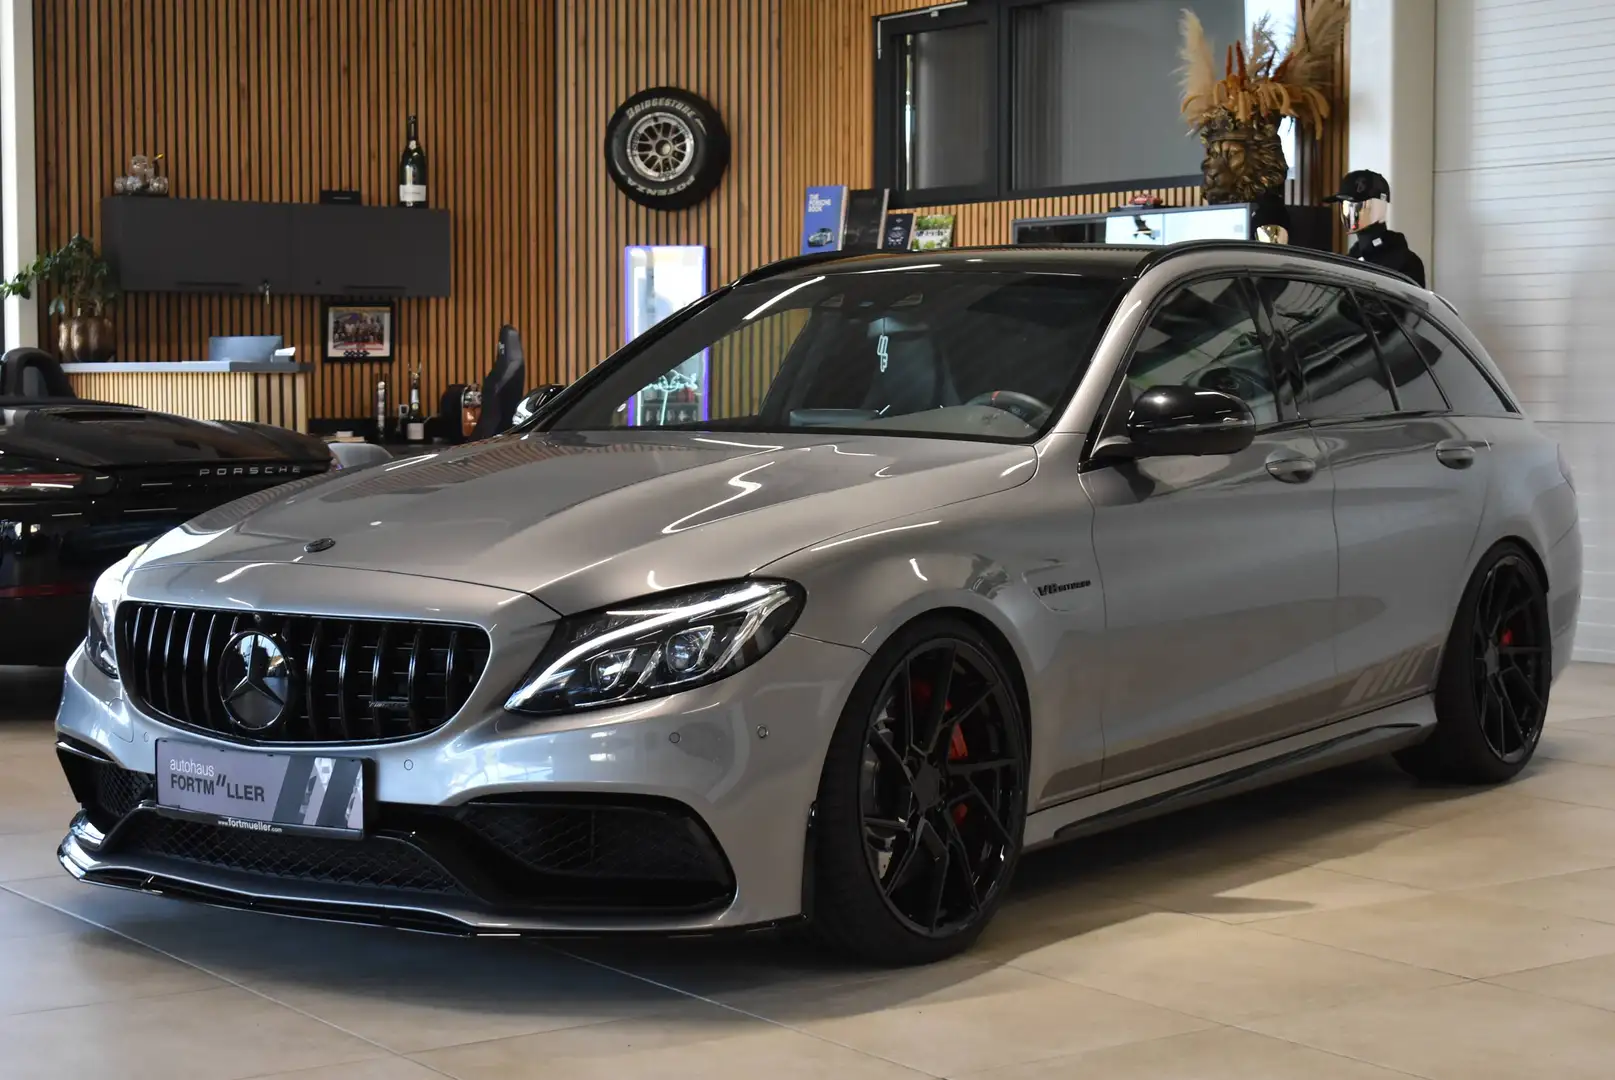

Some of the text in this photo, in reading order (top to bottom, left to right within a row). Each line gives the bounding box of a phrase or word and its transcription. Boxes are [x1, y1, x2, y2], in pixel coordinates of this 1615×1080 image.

[626, 98, 696, 120] BRIDGESTONE
[627, 175, 695, 196] POTENZA
[200, 466, 300, 476] PORSCHE
[169, 758, 215, 777] autohaus
[218, 817, 282, 833] www.fortmueller.com
